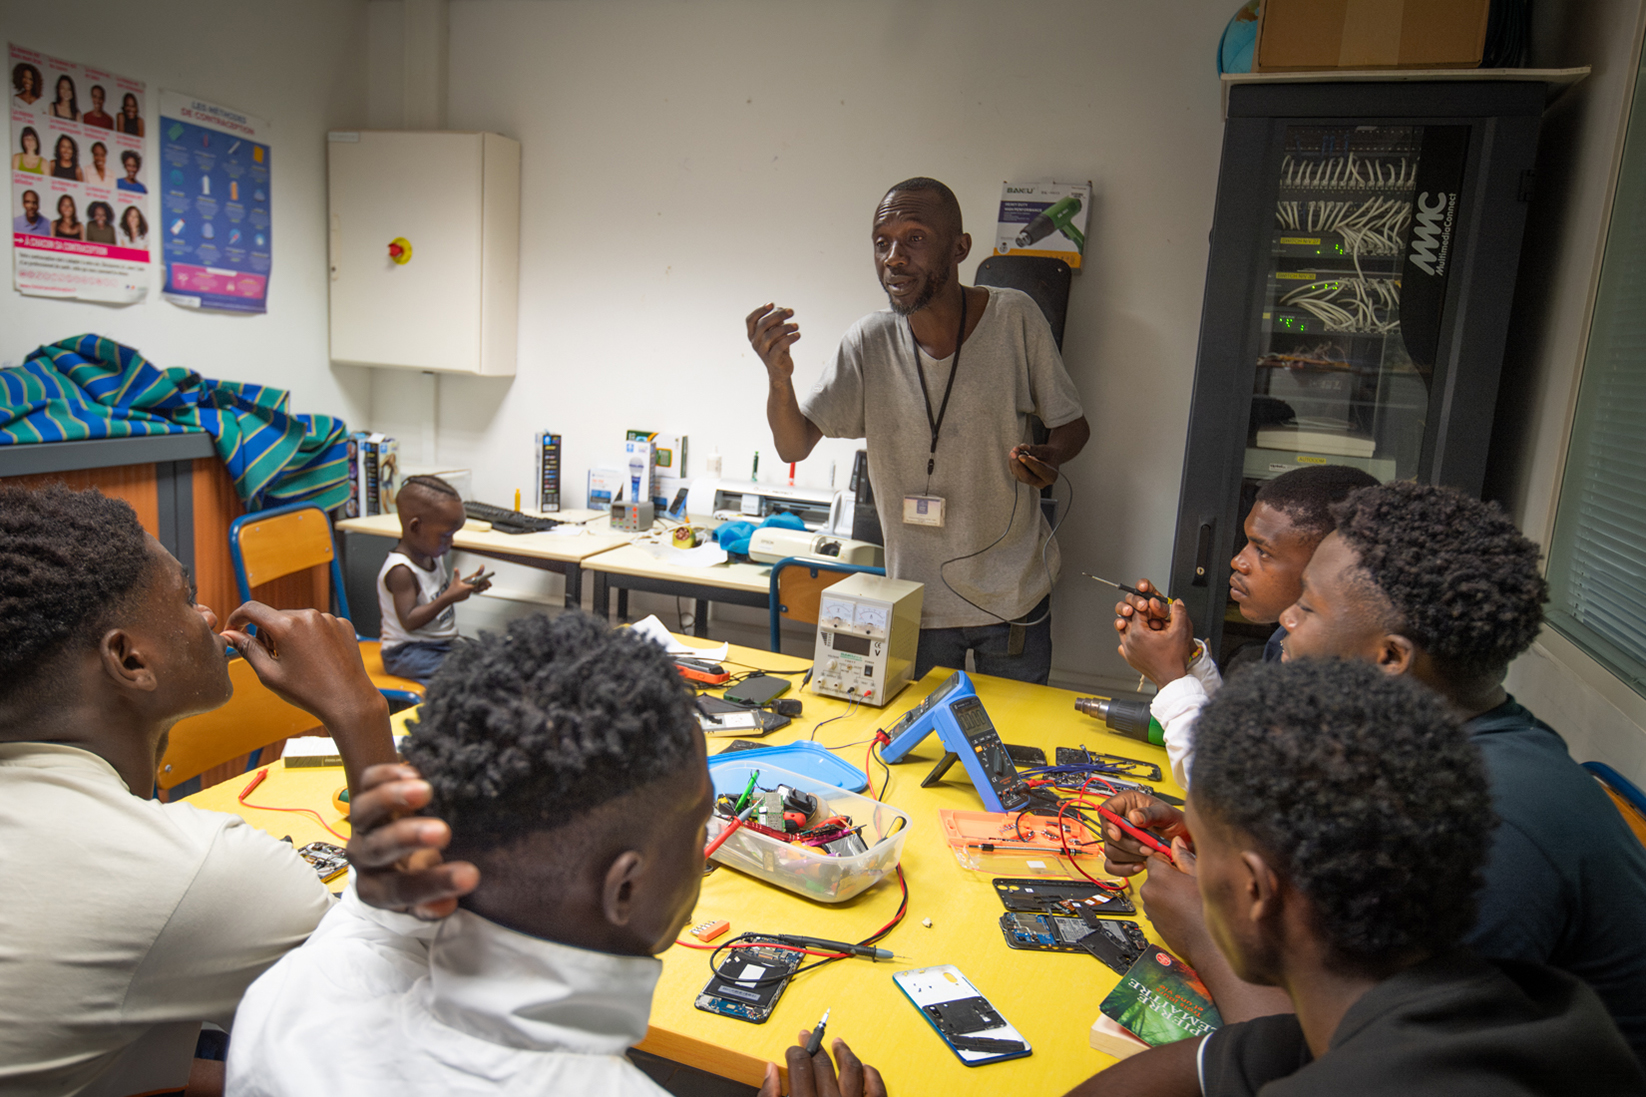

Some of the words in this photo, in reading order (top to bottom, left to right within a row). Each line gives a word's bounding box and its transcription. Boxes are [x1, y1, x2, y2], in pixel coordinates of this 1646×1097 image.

[181, 107, 194, 118] DE
[195, 110, 255, 136] CONTRACEPTION
[1409, 191, 1447, 276] MMC
[1435, 192, 1457, 277] MultimediaConnect
[1155, 987, 1179, 1005] jours
[1159, 984, 1173, 995] vie
[1174, 994, 1193, 1007] une
[1194, 1004, 1204, 1012] et
[1136, 993, 1202, 1037] PIERRE
[1180, 1002, 1202, 1019] Trois
